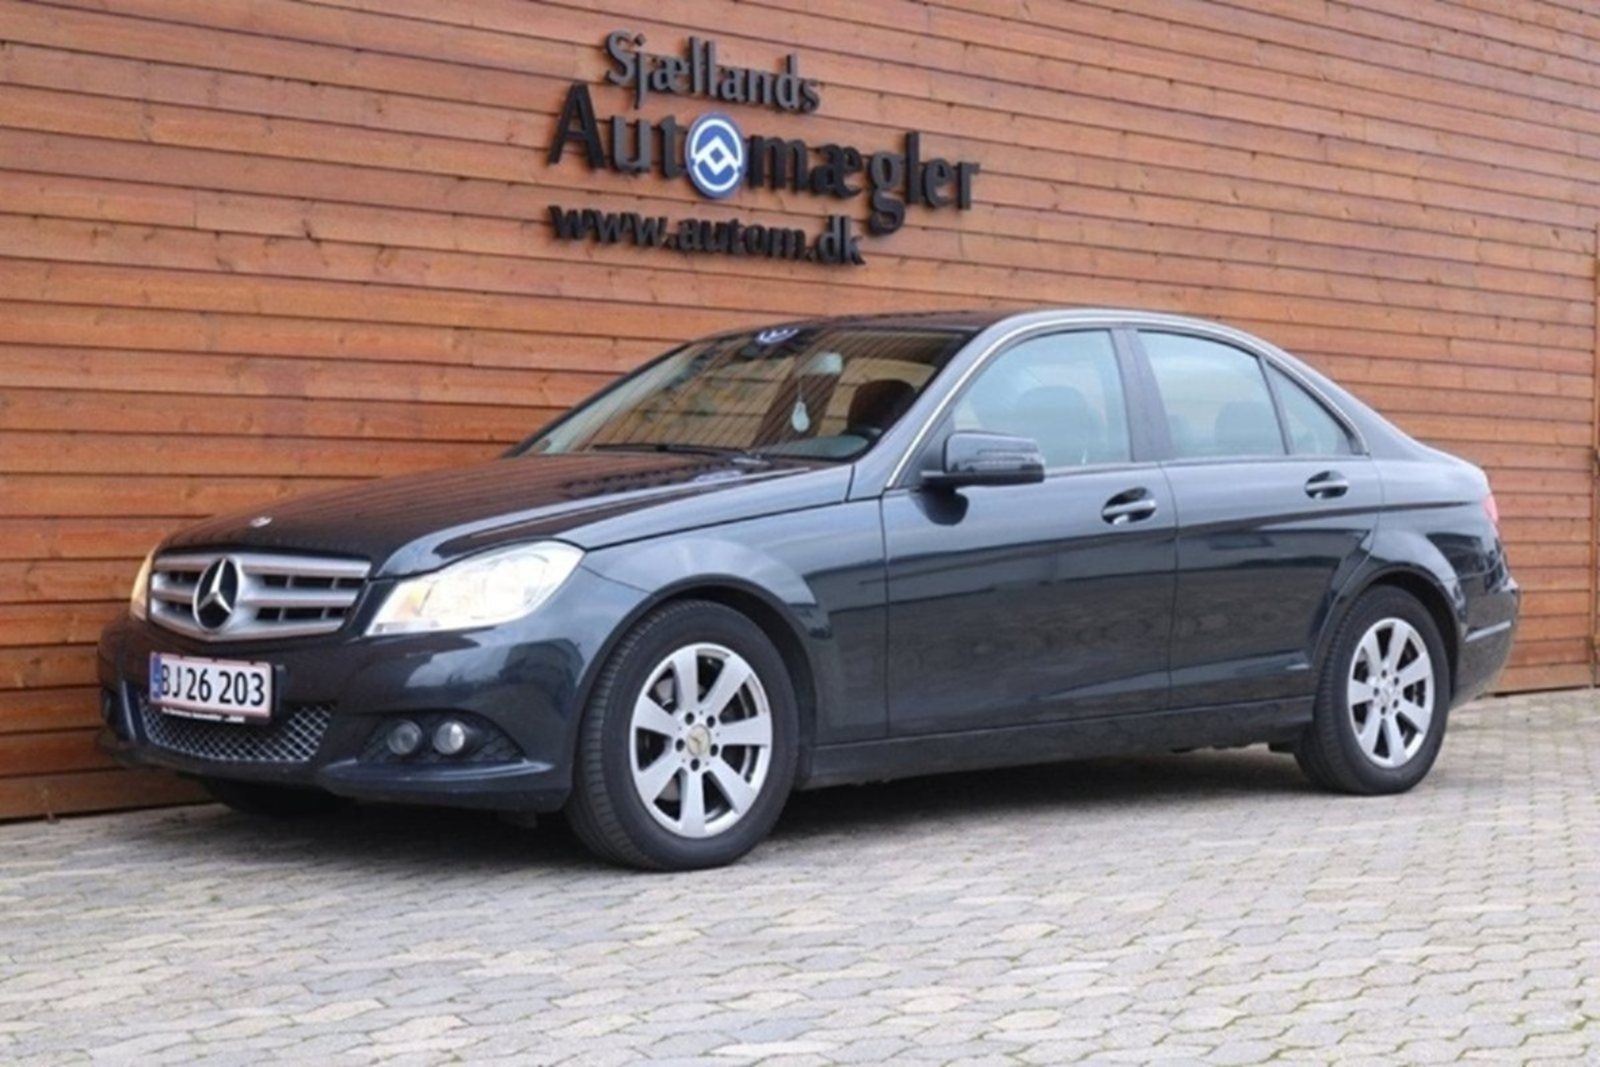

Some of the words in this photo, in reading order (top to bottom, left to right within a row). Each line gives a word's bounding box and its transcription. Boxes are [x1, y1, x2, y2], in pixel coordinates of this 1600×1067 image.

[605, 29, 821, 114] Sjællands
[548, 205, 866, 265] www.autom.dk
[218, 671, 265, 706] 203
